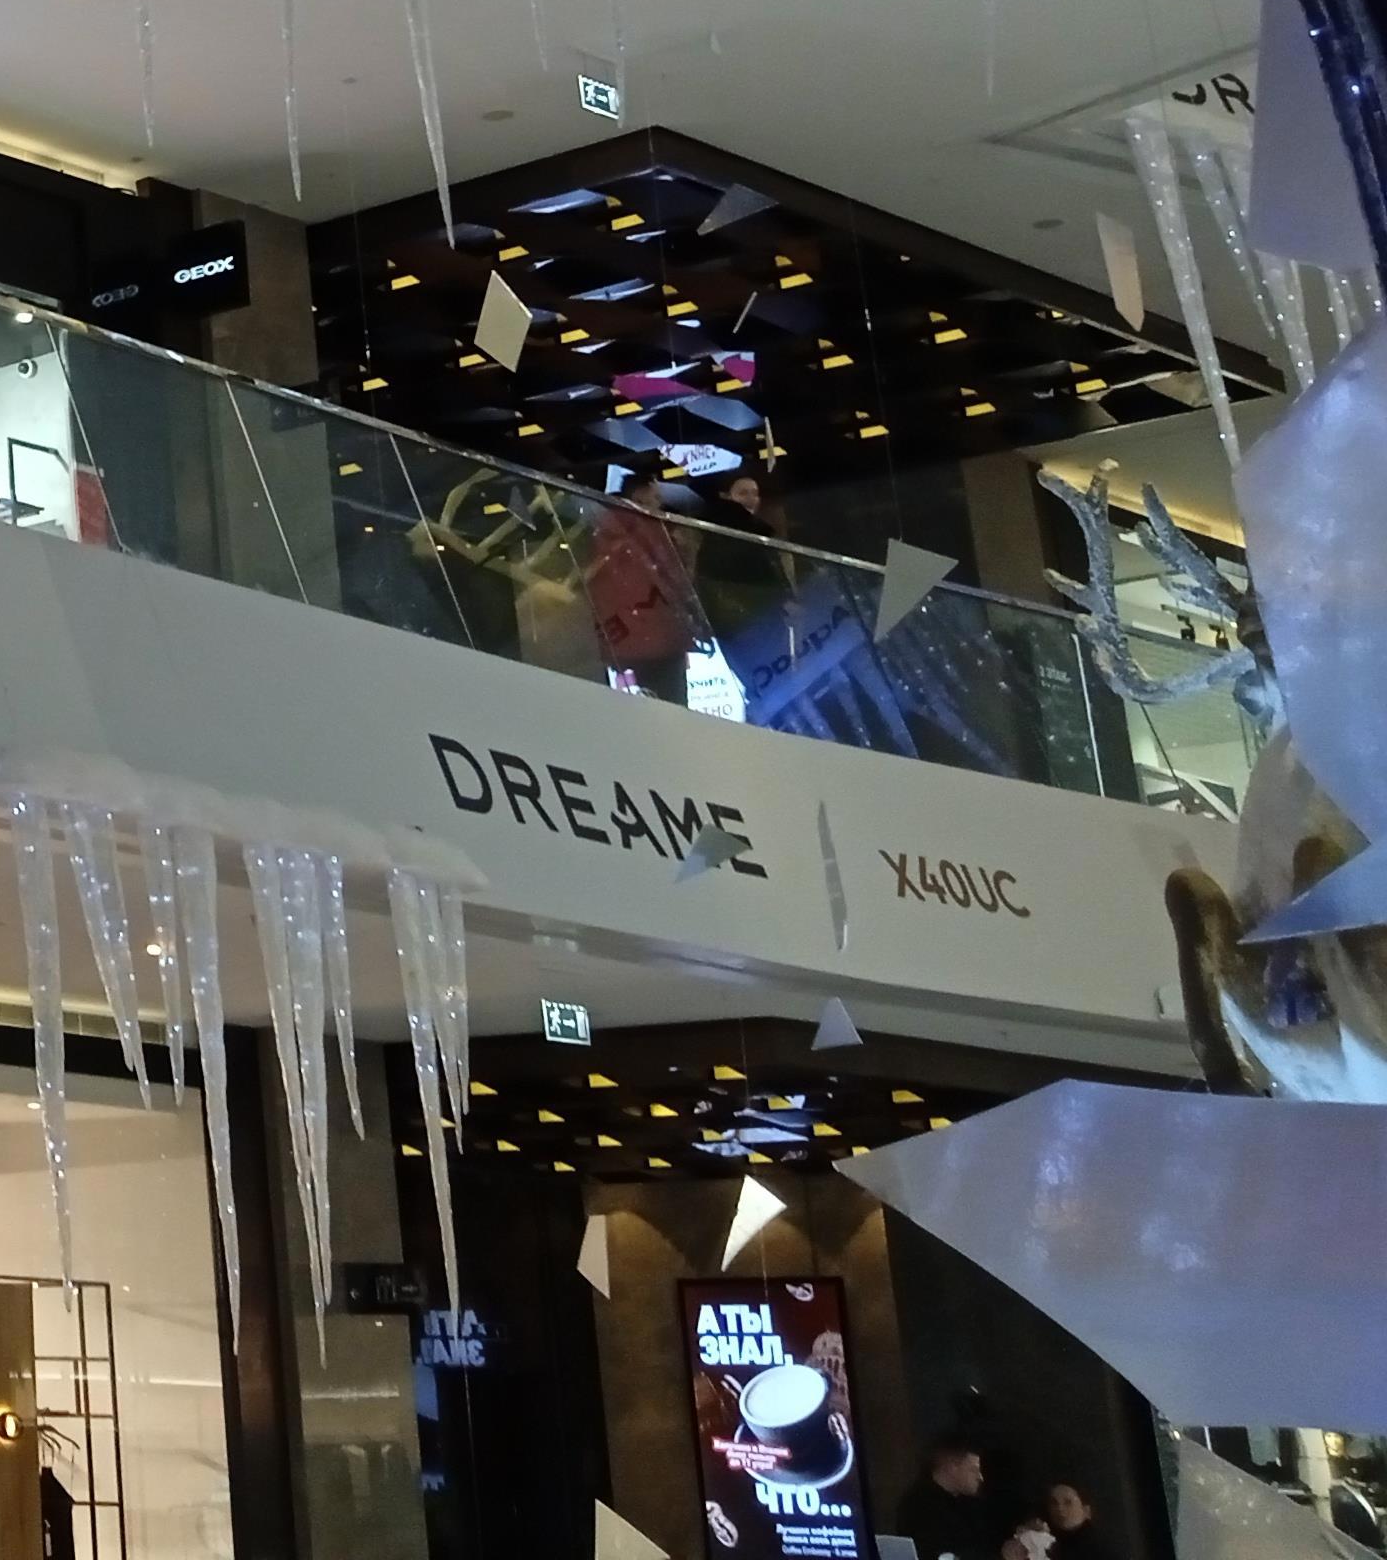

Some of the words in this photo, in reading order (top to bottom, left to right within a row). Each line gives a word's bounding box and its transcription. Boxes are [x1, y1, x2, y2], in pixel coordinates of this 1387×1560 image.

[173, 256, 235, 284] GEOX
[428, 733, 769, 880] DREAME
[878, 849, 1032, 918] X40UC
[719, 1303, 773, 1334] ТЫ
[698, 1335, 794, 1368] ЗНАЛ,
[755, 1482, 852, 1517] ЧТО...
